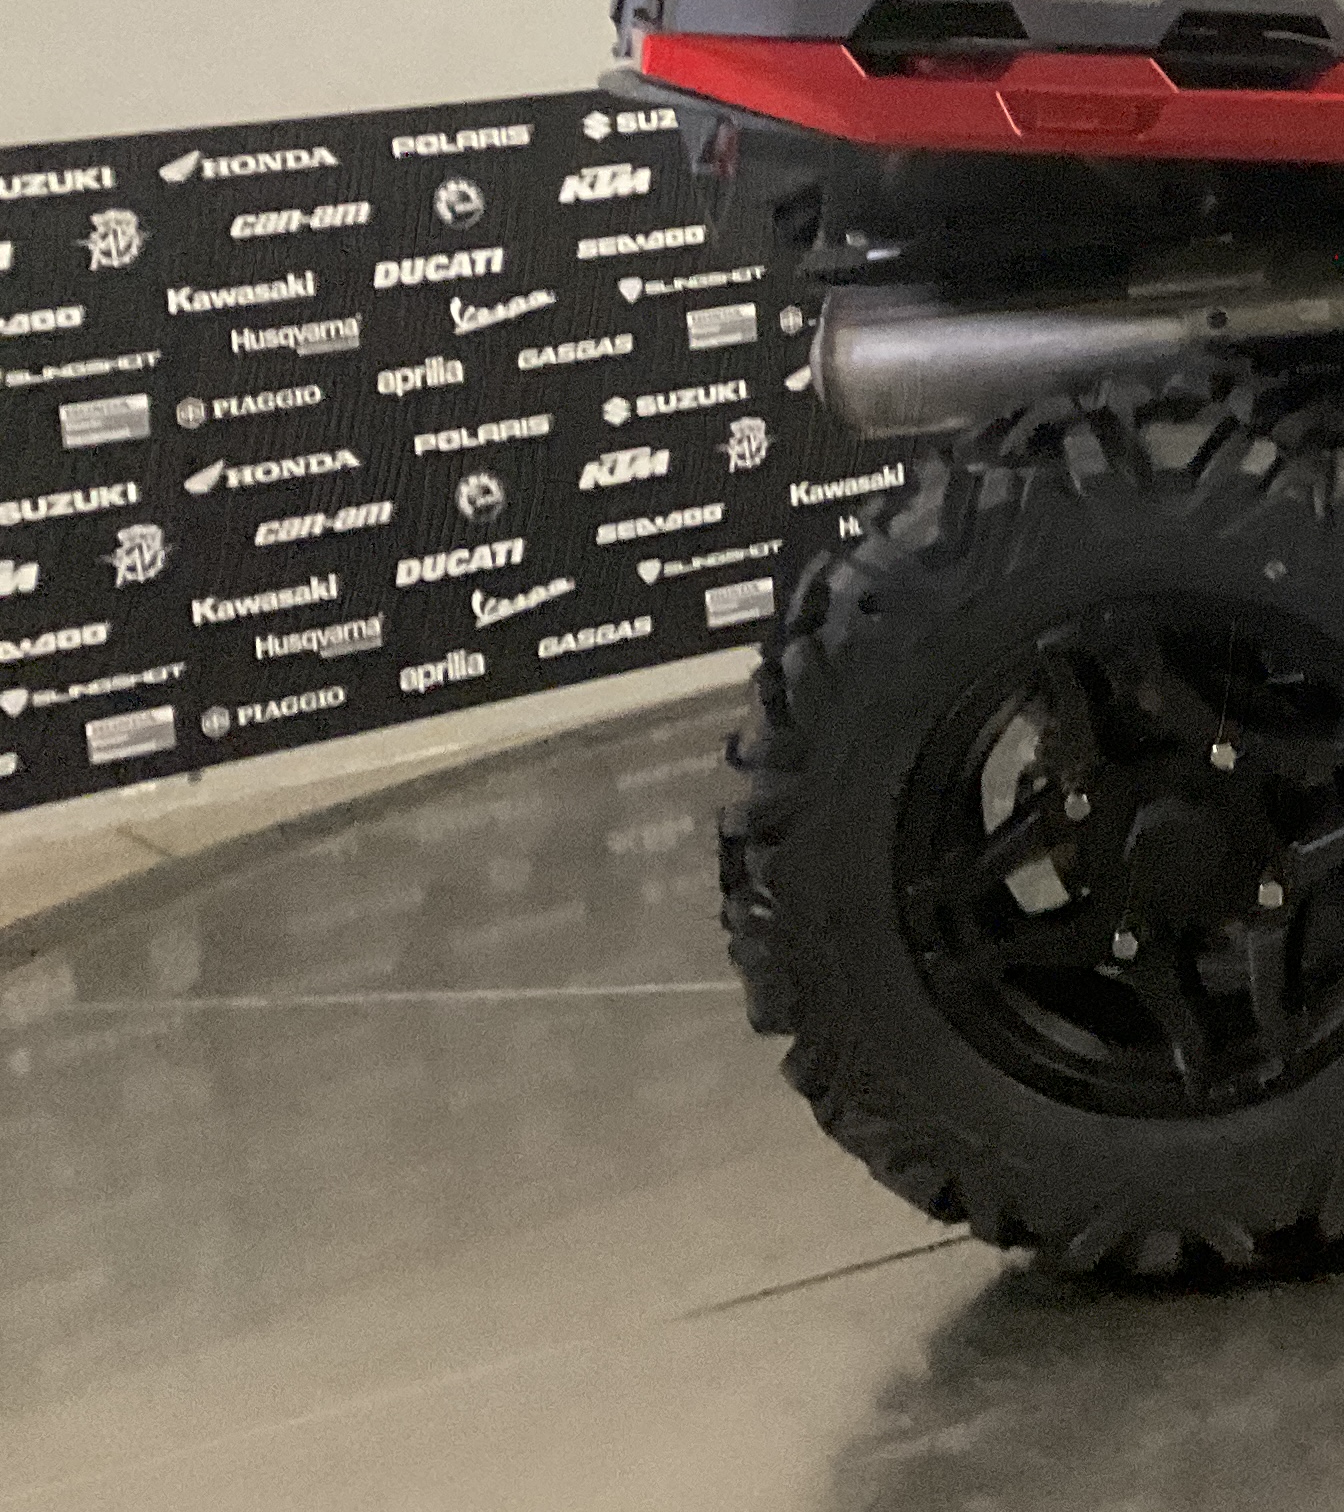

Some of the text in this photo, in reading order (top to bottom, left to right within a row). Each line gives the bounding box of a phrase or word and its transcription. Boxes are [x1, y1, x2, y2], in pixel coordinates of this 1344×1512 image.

[617, 109, 678, 133] SUZ
[392, 125, 530, 158] POLARIS
[202, 147, 338, 178] HONDA
[0, 167, 113, 199] UZUKI
[559, 164, 651, 203] KTM
[374, 248, 503, 288] DUCATI
[168, 271, 314, 314] Kawasaki
[450, 291, 555, 334] Vespa
[518, 334, 632, 369] GASGAS
[213, 385, 321, 418] PIAGGIO
[637, 380, 747, 416] SUZUKI
[415, 415, 549, 455] POLARIS
[226, 450, 360, 487] HONDA
[579, 447, 669, 489] KTM
[790, 463, 904, 506] Kawasaki
[396, 538, 524, 586] DUCATI
[192, 574, 337, 625] Kawasaki
[472, 578, 574, 627] Vespa
[538, 616, 651, 658] GASGAS
[238, 687, 345, 725] PIAGGIO
